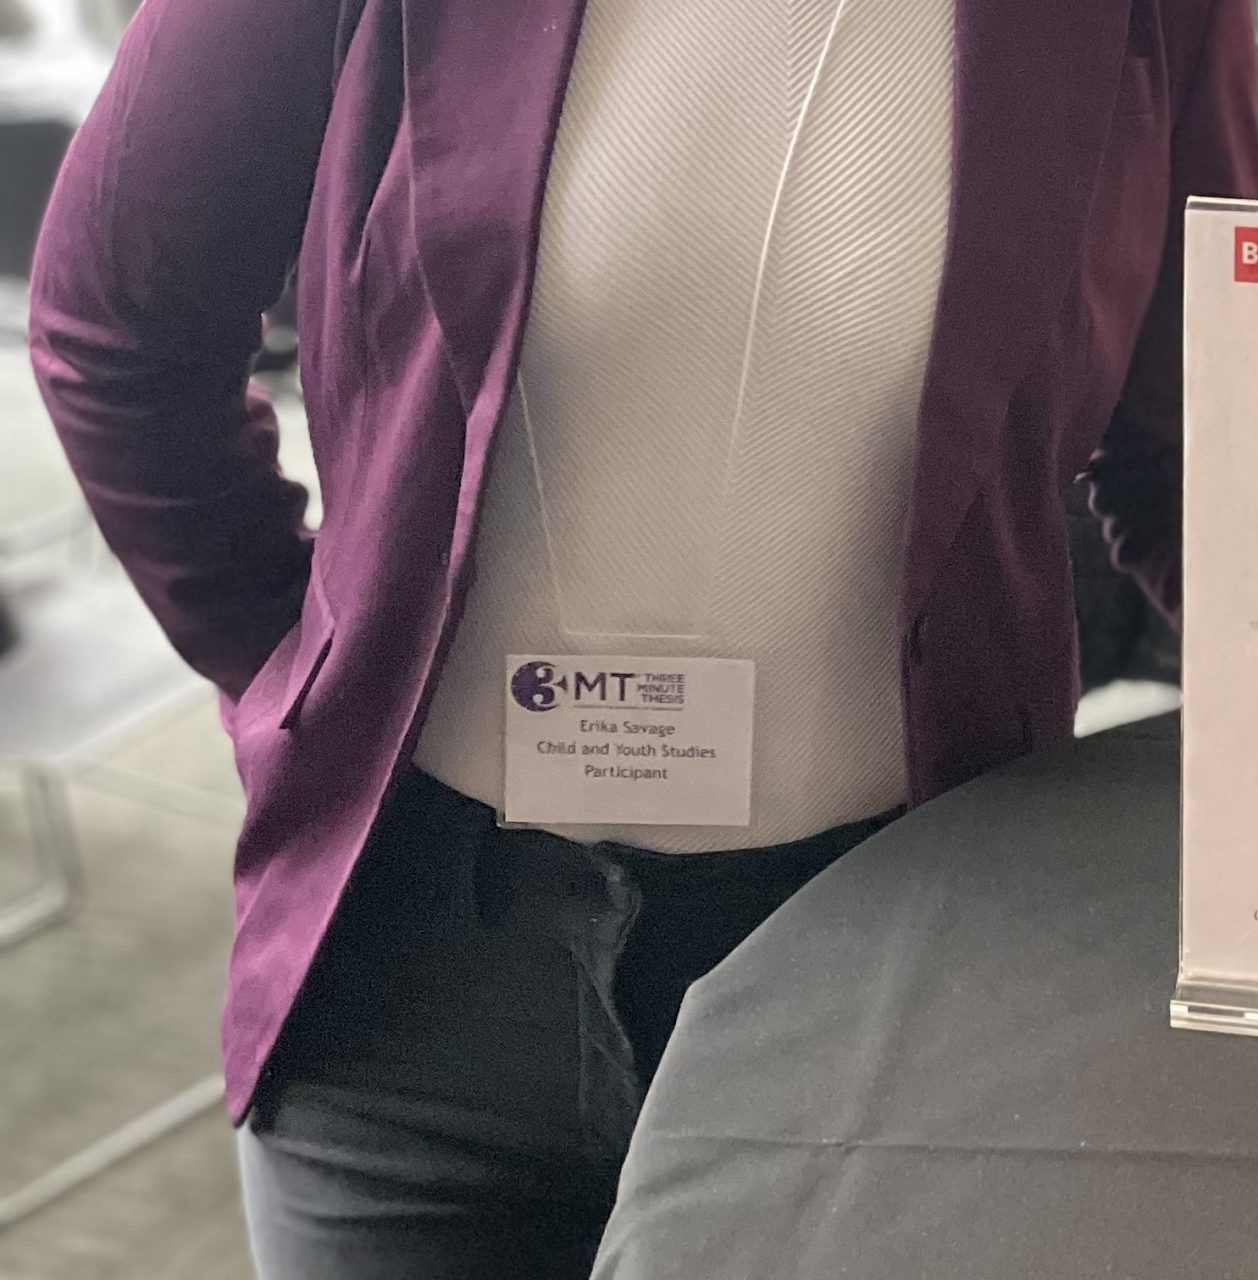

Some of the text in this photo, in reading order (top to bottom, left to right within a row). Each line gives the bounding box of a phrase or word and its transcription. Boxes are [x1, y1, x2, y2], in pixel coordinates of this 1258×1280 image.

[645, 673, 684, 682] THREE
[637, 684, 684, 693] MINUTE
[642, 694, 684, 704] THESIS
[579, 719, 675, 737] Erika Savage
[537, 741, 716, 758] Child and Youth Studies
[584, 764, 668, 781] Participant
